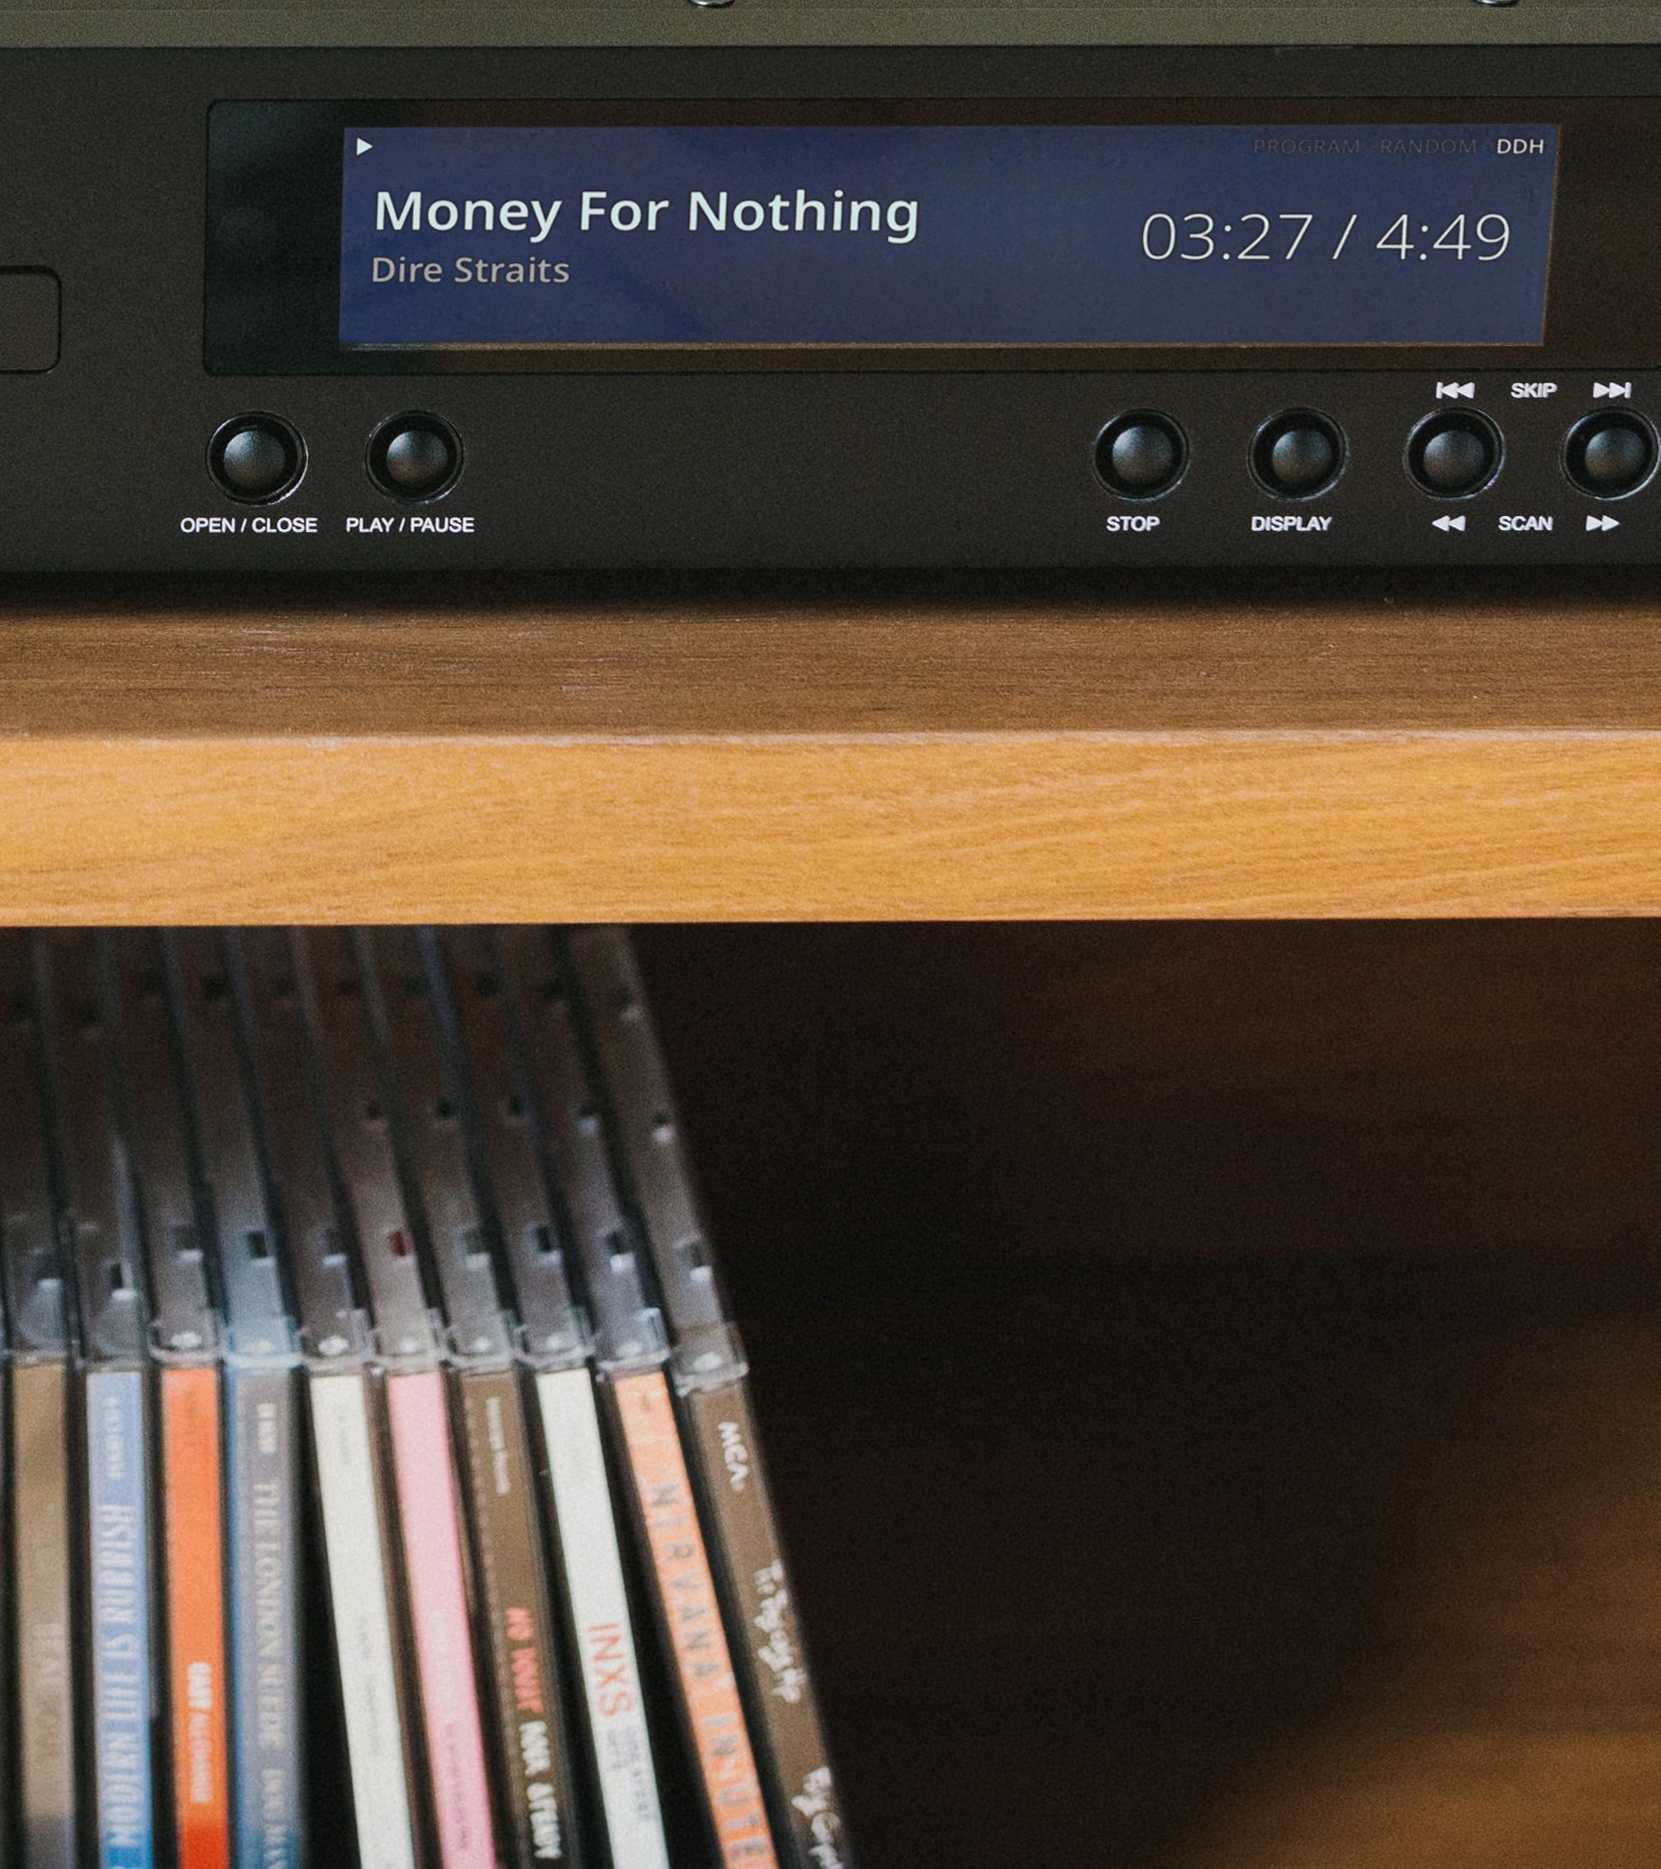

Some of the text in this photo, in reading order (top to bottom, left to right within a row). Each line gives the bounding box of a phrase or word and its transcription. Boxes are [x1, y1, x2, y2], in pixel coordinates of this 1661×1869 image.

[1253, 138, 1545, 155] PROGRAM RANDOM DDH
[376, 188, 919, 244] Money For Nothing
[1141, 212, 1314, 261] 03:27
[1376, 213, 1511, 261] 4:49
[371, 256, 571, 283] Dire Straits
[1510, 382, 1558, 399] SKIP
[179, 517, 236, 533] OPEN
[251, 517, 318, 533] CLOSE
[346, 517, 394, 533] PLAY
[410, 517, 475, 533] PAUSE
[1106, 515, 1161, 533] STOP
[1250, 515, 1333, 533] DISPLAY
[1497, 515, 1554, 533] SCAN
[253, 1479, 281, 1531] THE
[97, 1504, 137, 1625] RUBBISH
[254, 1541, 286, 1659] LONDON
[647, 1481, 722, 1681] NIRVANA
[701, 1713, 740, 1759] IN
[101, 1633, 140, 1660] IS
[588, 1621, 637, 1718] INXS
[101, 1672, 141, 1721] LIFE
[103, 1733, 143, 1848] MODERN
